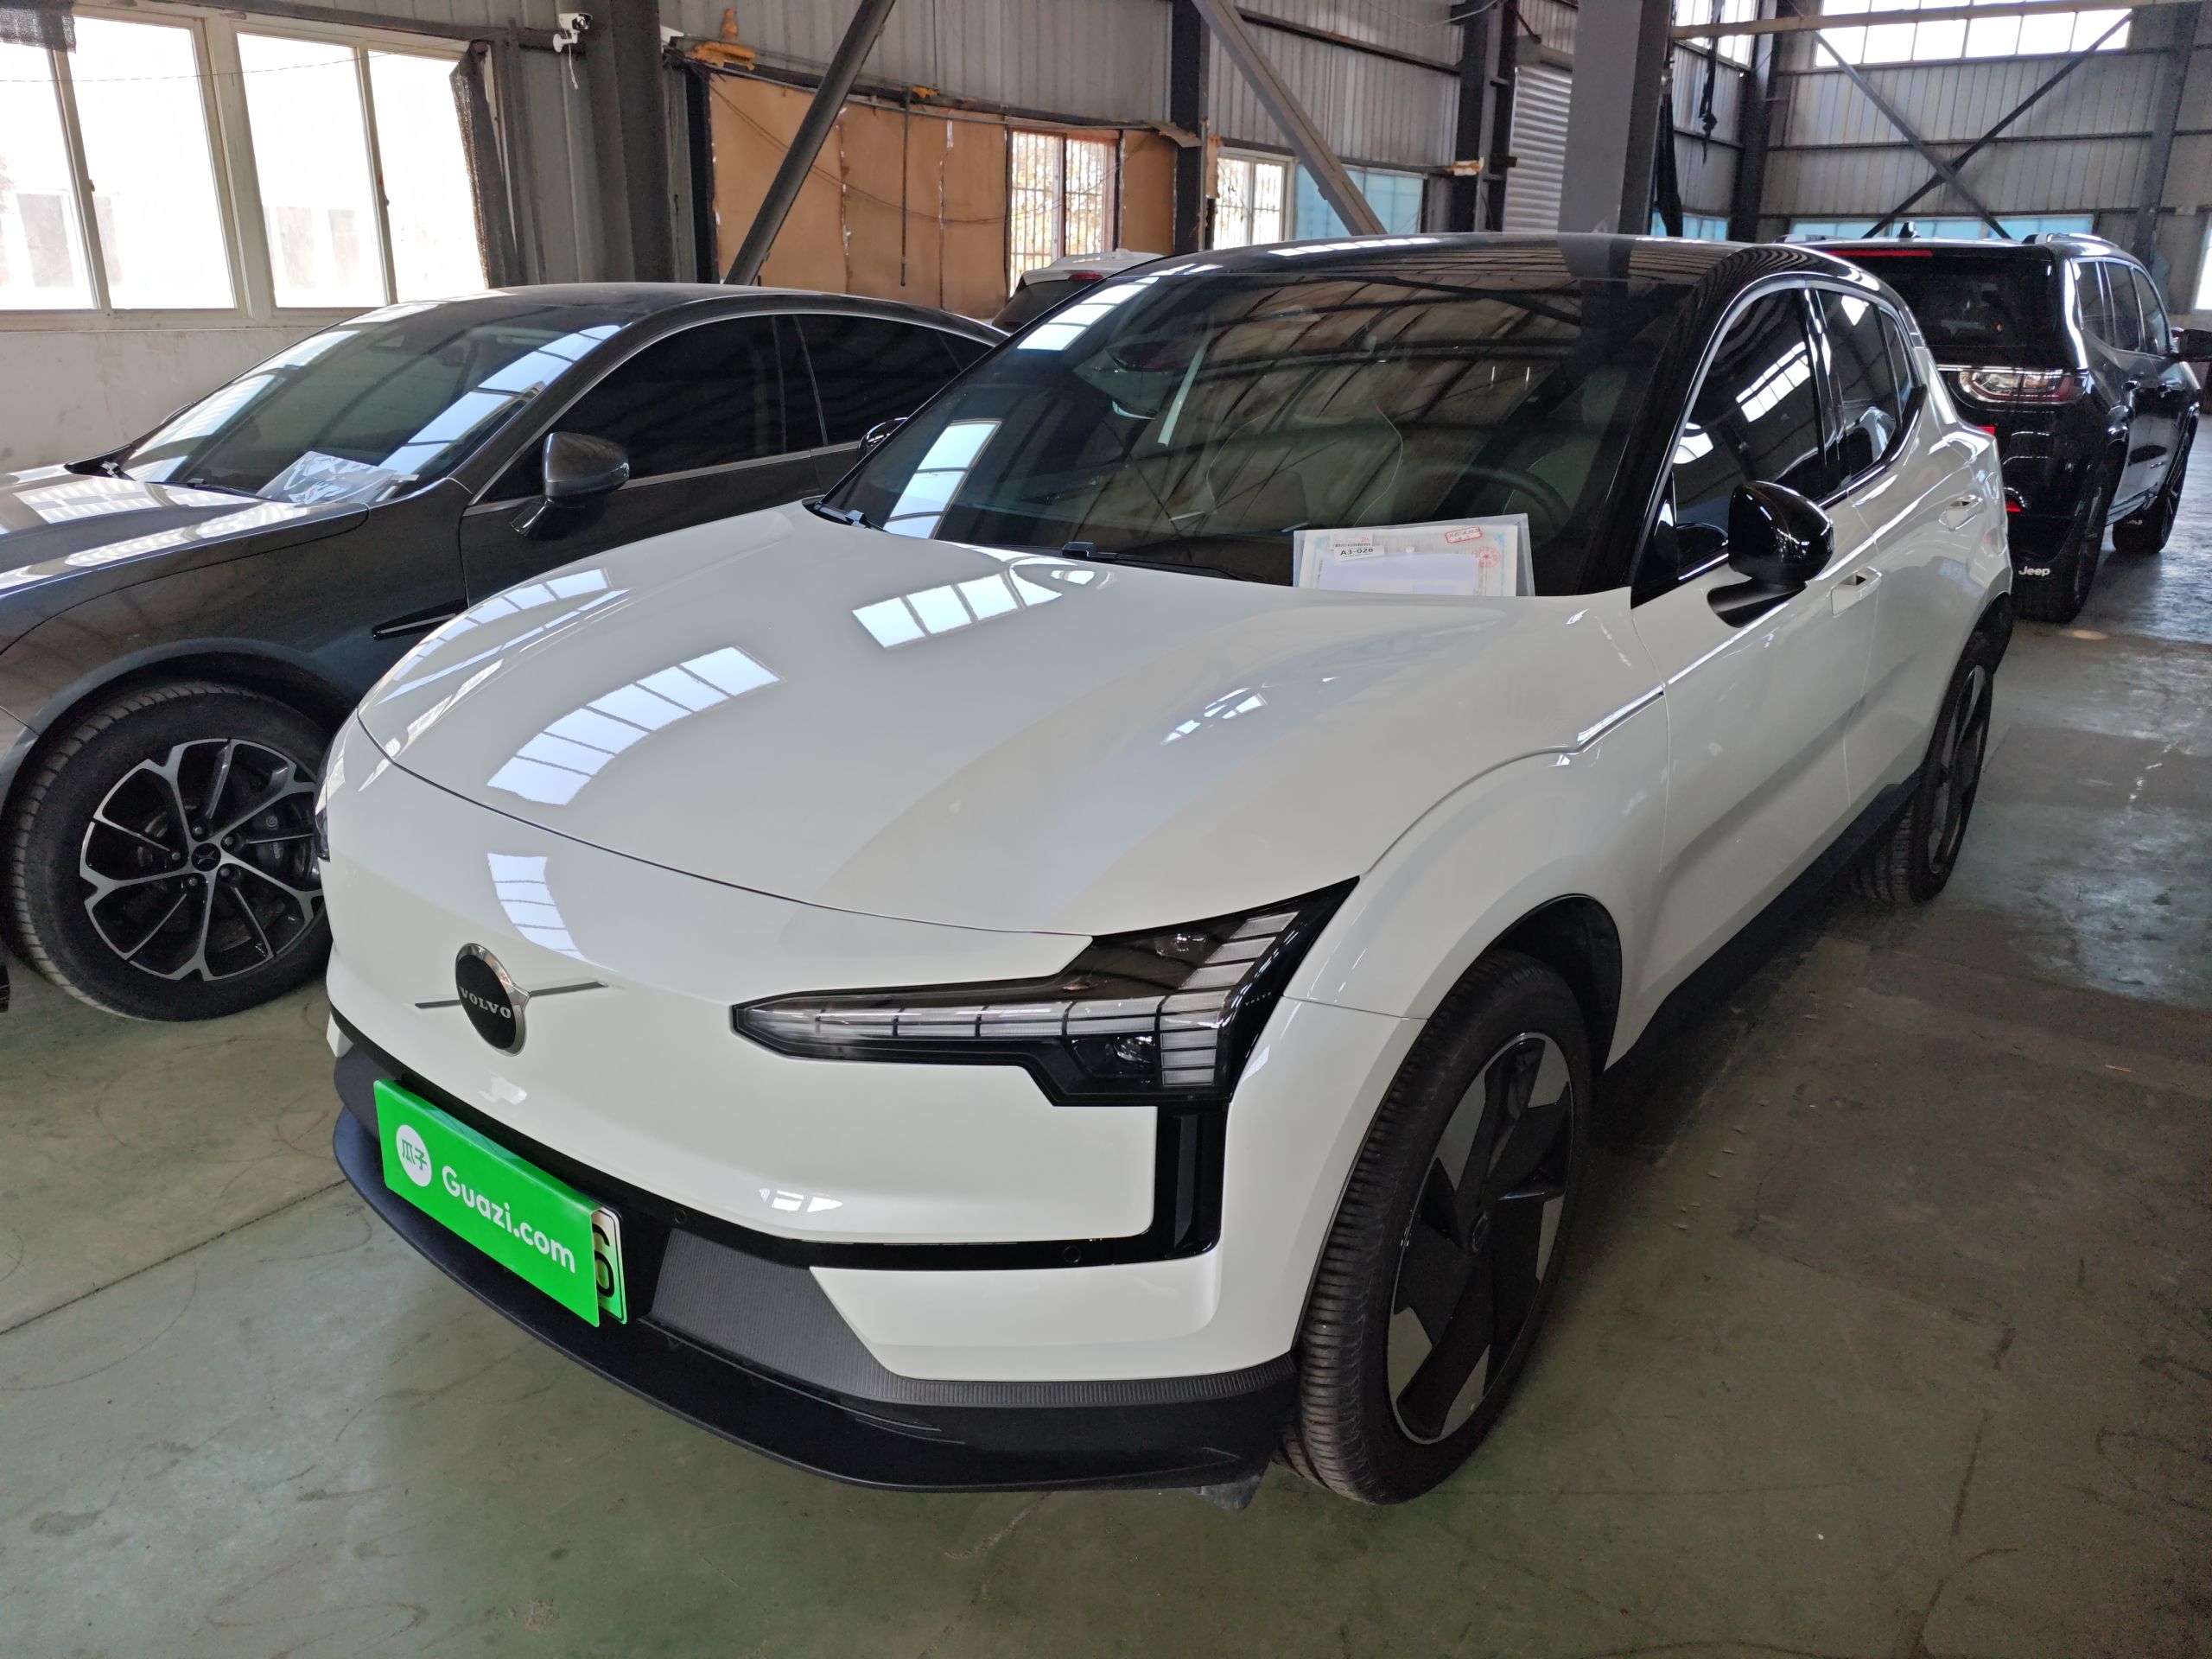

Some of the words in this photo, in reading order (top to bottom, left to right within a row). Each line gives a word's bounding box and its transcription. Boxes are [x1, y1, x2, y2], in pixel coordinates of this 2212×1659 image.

[2018, 565, 2050, 577] Jeep
[459, 986, 512, 1019] VOLVO
[401, 1138, 428, 1172] 瓜子
[442, 1165, 575, 1274] Guazi.com
